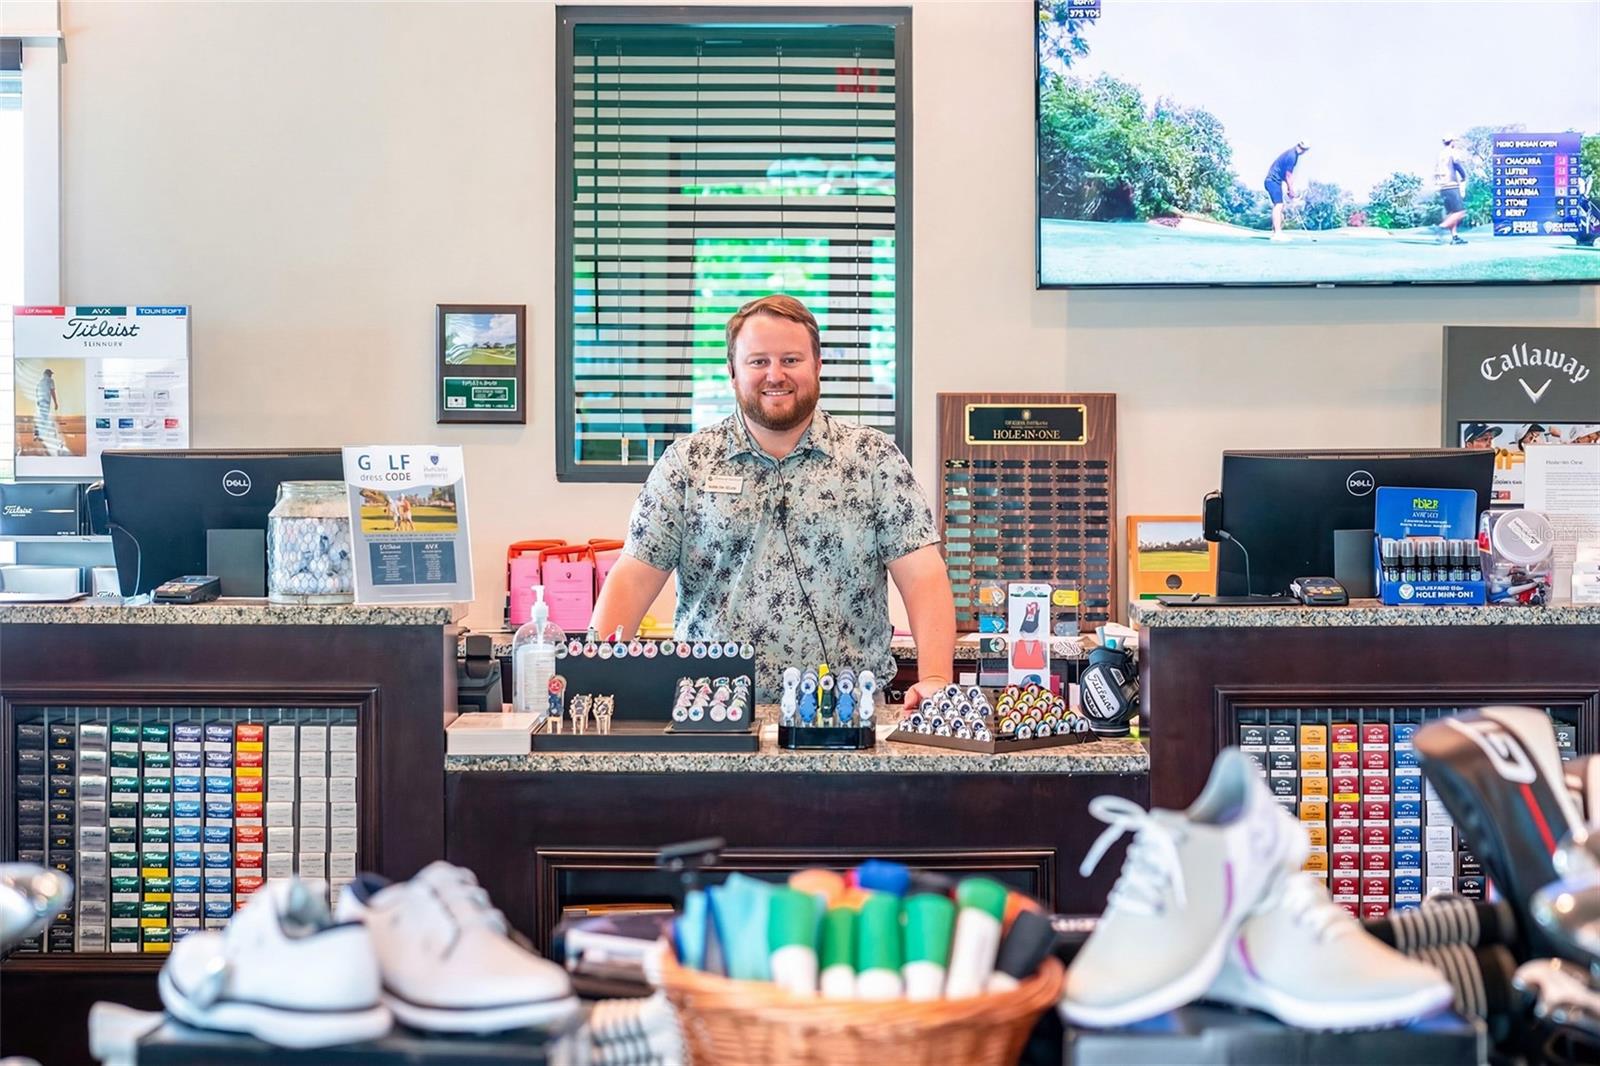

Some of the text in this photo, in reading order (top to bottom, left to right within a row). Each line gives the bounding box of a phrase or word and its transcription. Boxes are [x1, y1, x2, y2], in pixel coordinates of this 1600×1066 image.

[62, 316, 140, 340] Titleist
[1481, 342, 1590, 383] Callaway
[385, 472, 411, 481] CODE
